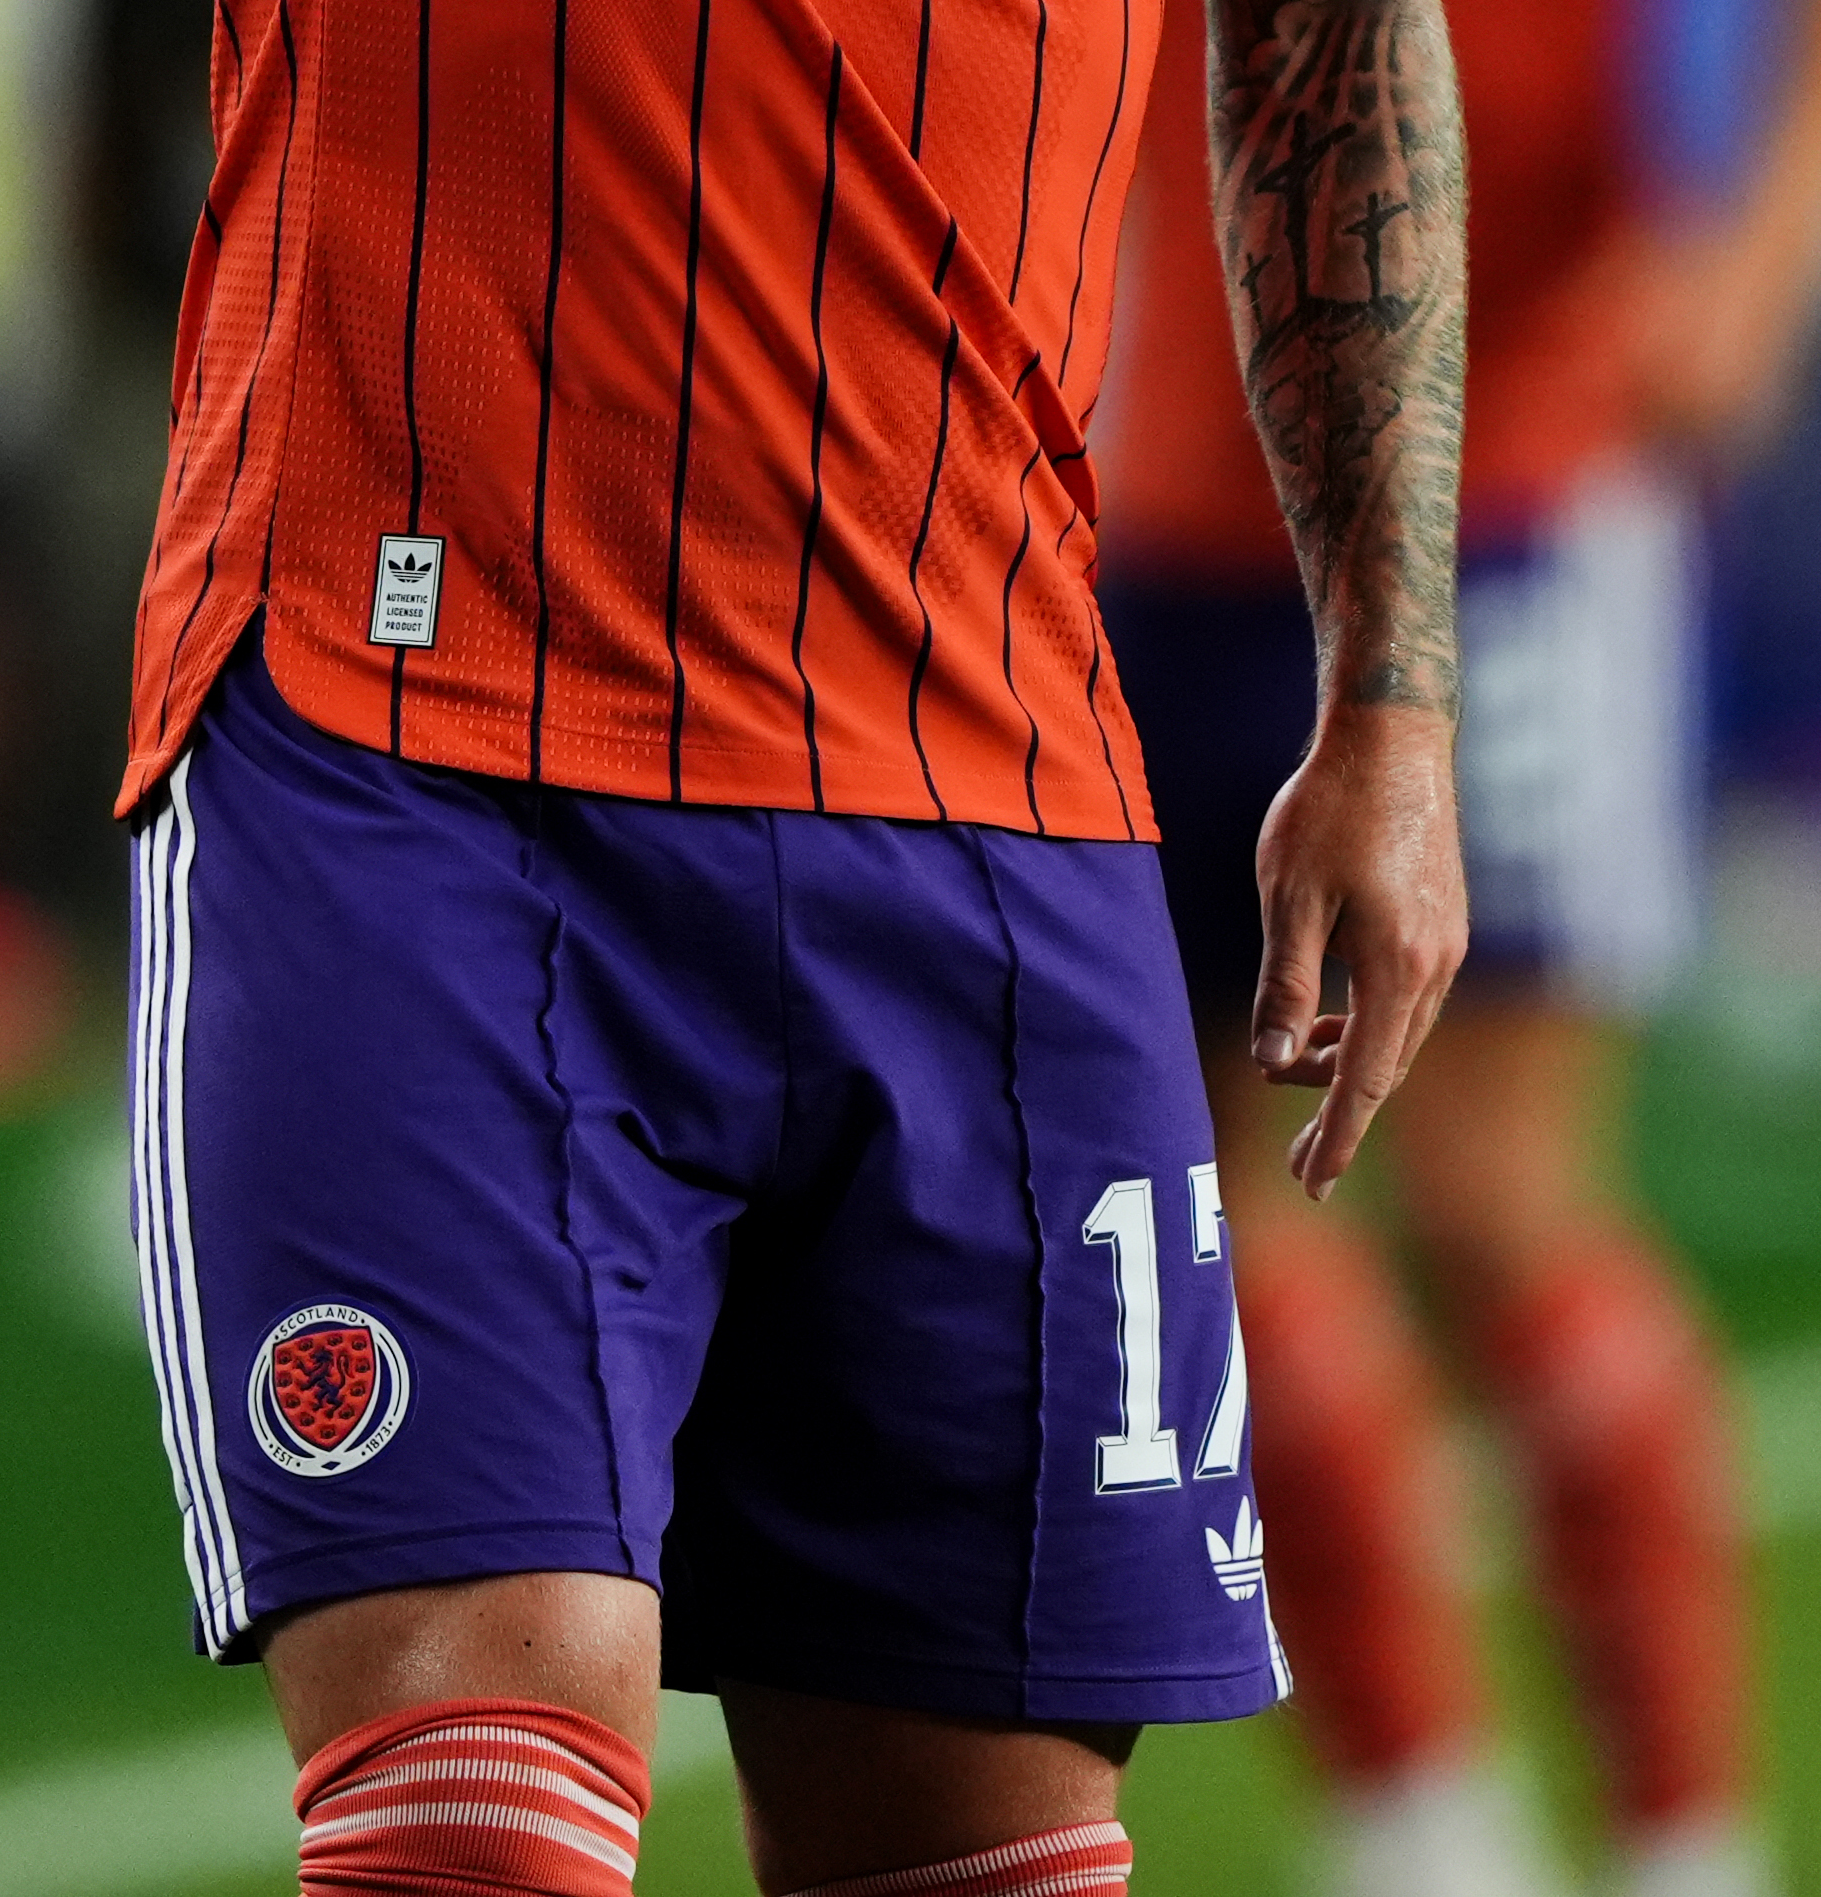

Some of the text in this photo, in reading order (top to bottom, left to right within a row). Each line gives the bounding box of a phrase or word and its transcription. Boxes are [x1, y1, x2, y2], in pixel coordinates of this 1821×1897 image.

[386, 593, 429, 604] AUTHENTIC
[386, 607, 424, 618] LICENSED
[384, 621, 423, 632] PRODUCT
[280, 1307, 359, 1337] SCOTLAND
[365, 1425, 392, 1454] 1873
[271, 1447, 295, 1466] EST
